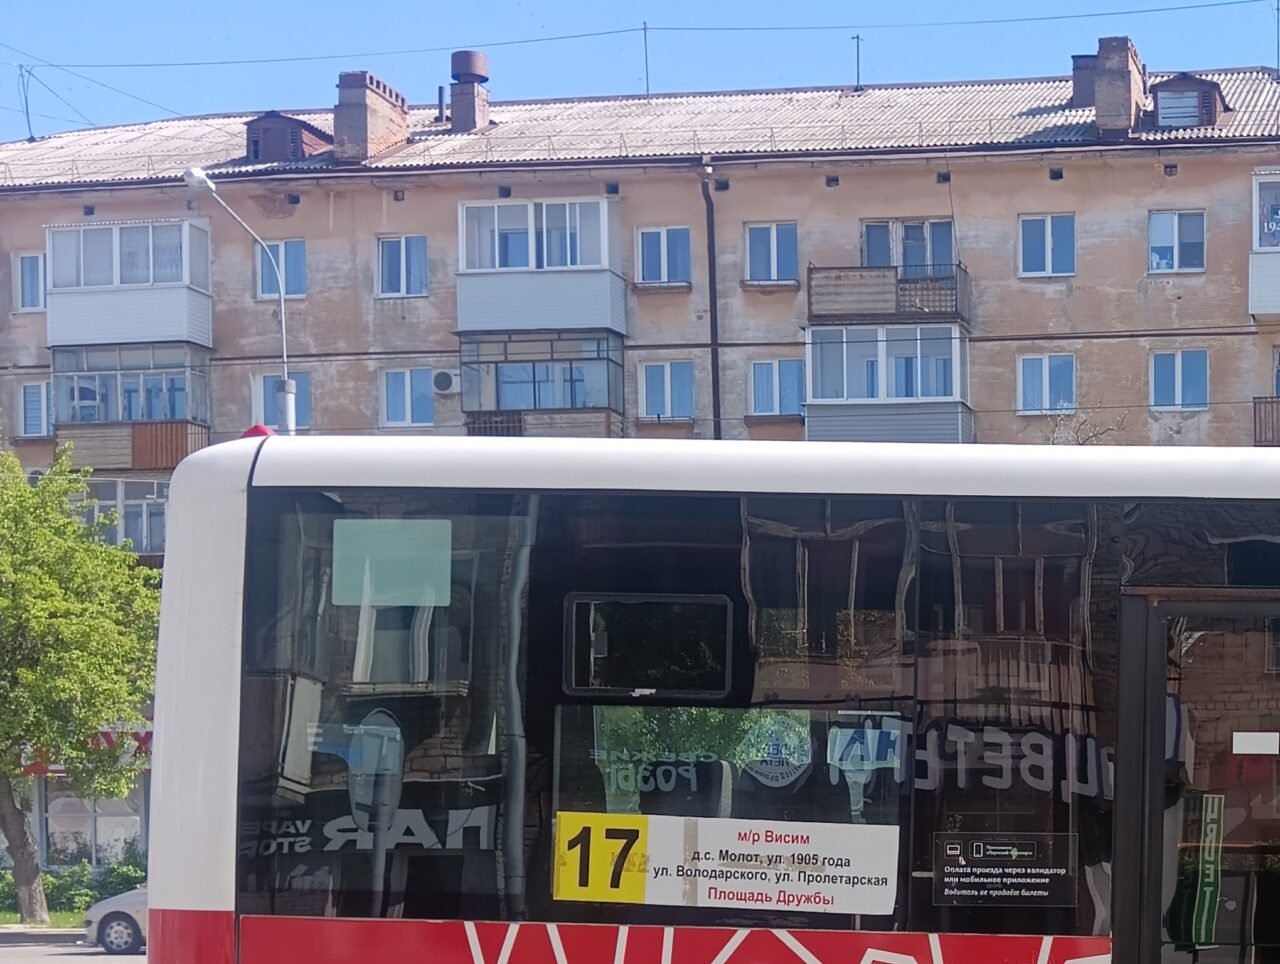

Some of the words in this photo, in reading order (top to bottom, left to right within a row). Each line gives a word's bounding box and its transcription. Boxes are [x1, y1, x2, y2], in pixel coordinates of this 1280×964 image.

[737, 829, 760, 845] м/р
[765, 830, 810, 844] Висим
[567, 826, 639, 889] 17
[692, 850, 714, 862] д.с.
[718, 849, 763, 865] Молот,
[767, 854, 785, 866] ул.
[790, 853, 819, 865] 1905
[822, 856, 851, 868] года
[653, 866, 672, 878] ул.
[676, 865, 771, 883] Володарского,
[775, 872, 793, 884] ул.
[798, 871, 888, 887] Пролетарская
[1004, 867, 1025, 875] через
[960, 875, 1001, 883] мобильное
[1003, 877, 1049, 885] приложение
[708, 886, 772, 904] Площадь
[776, 890, 834, 907] Дружбы
[944, 888, 978, 896] Водитель
